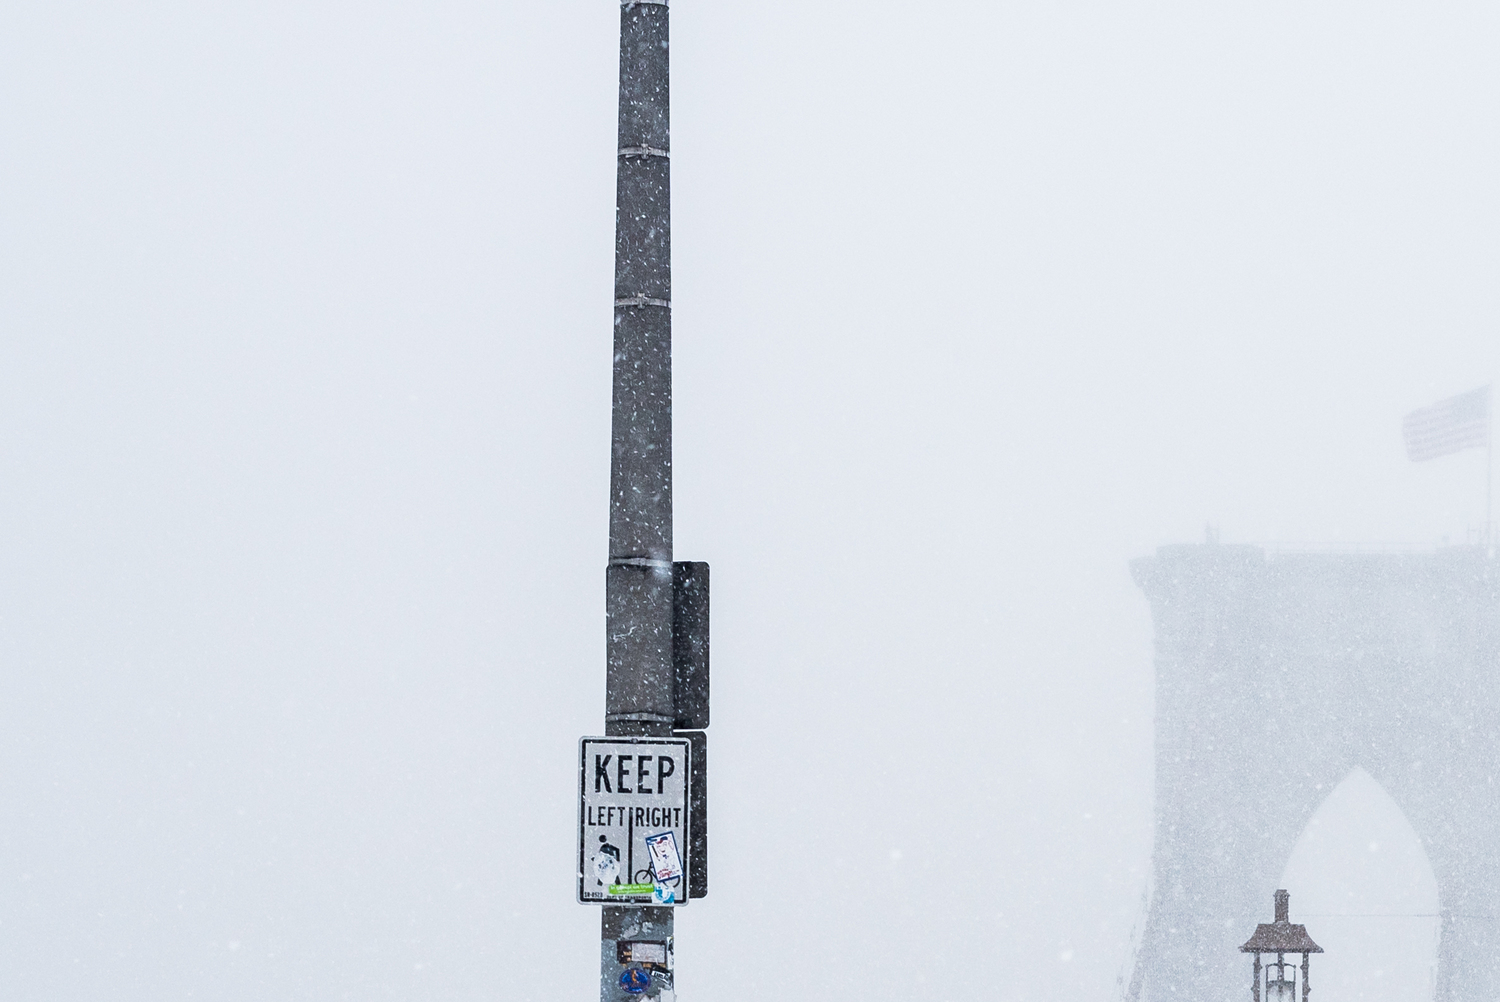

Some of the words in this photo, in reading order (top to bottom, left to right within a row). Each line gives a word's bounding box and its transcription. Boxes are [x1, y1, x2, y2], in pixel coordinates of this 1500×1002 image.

[594, 754, 675, 794] KEEP
[588, 806, 626, 827] LEFT
[635, 807, 681, 828] RIGHT
